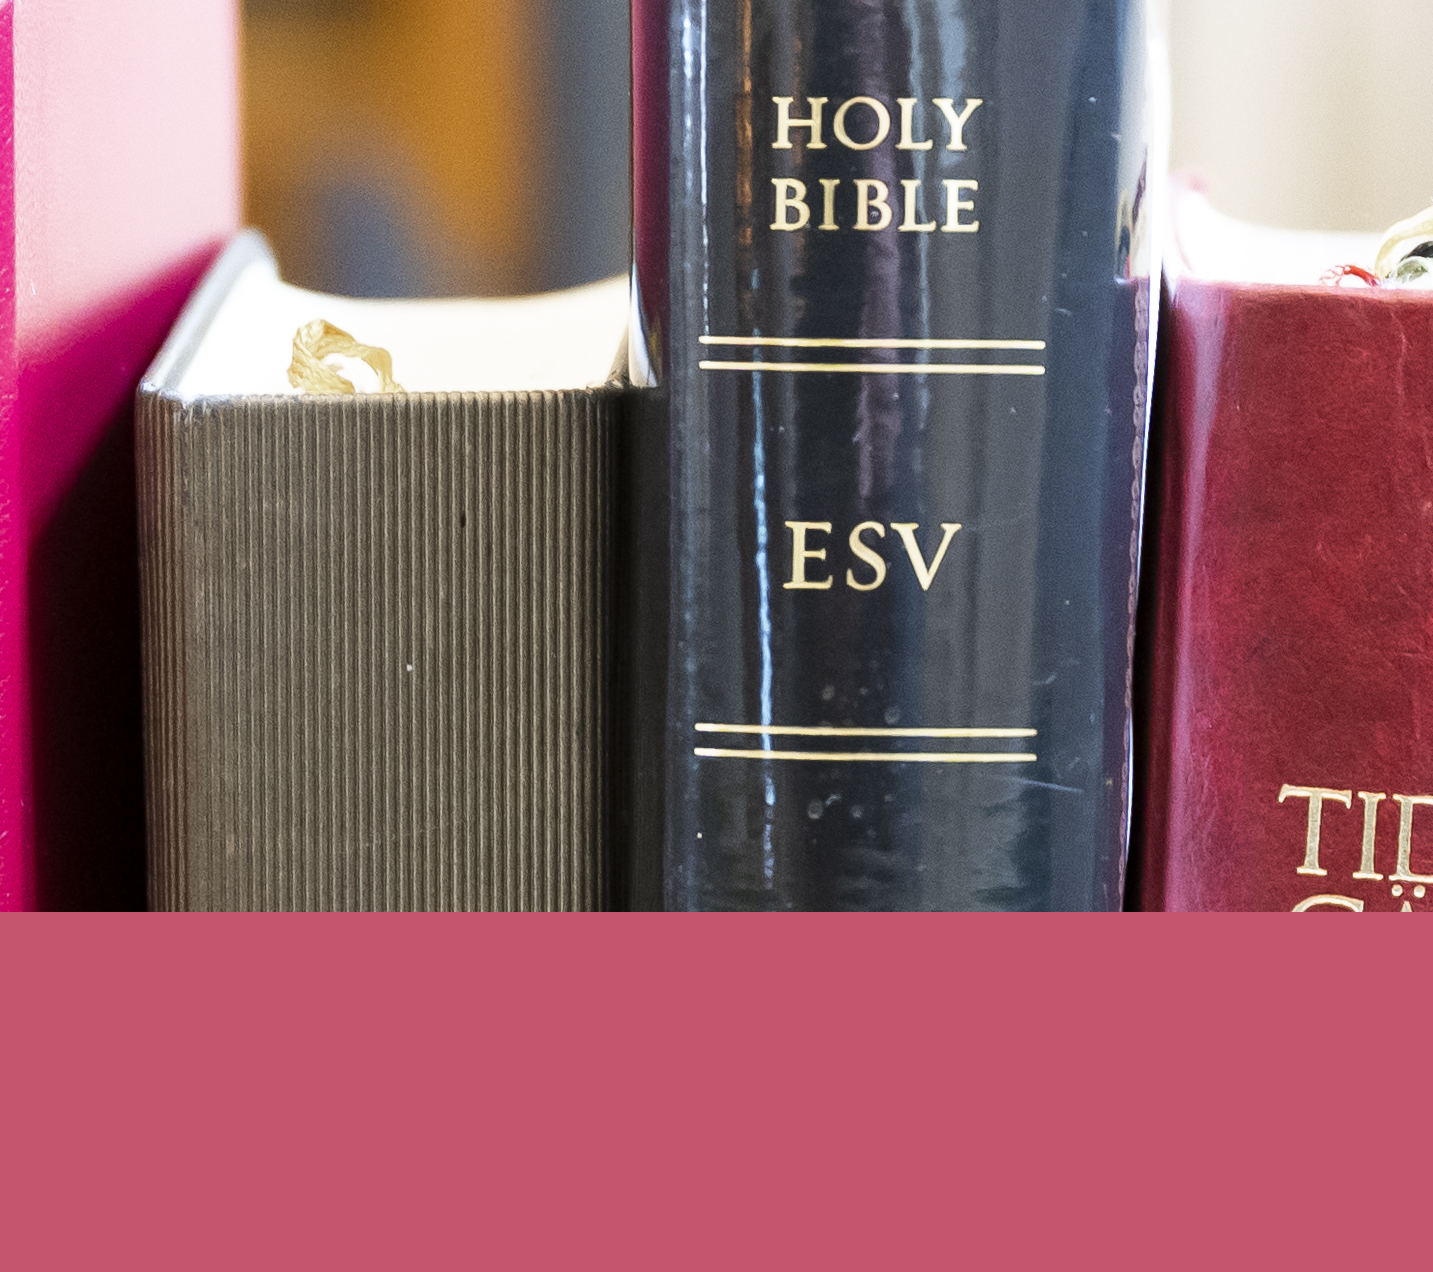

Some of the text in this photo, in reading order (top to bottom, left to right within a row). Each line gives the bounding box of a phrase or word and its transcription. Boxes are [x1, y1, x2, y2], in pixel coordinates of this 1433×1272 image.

[771, 96, 983, 151] HOLY
[769, 177, 980, 233] BIBLE
[783, 520, 962, 591] ESV
